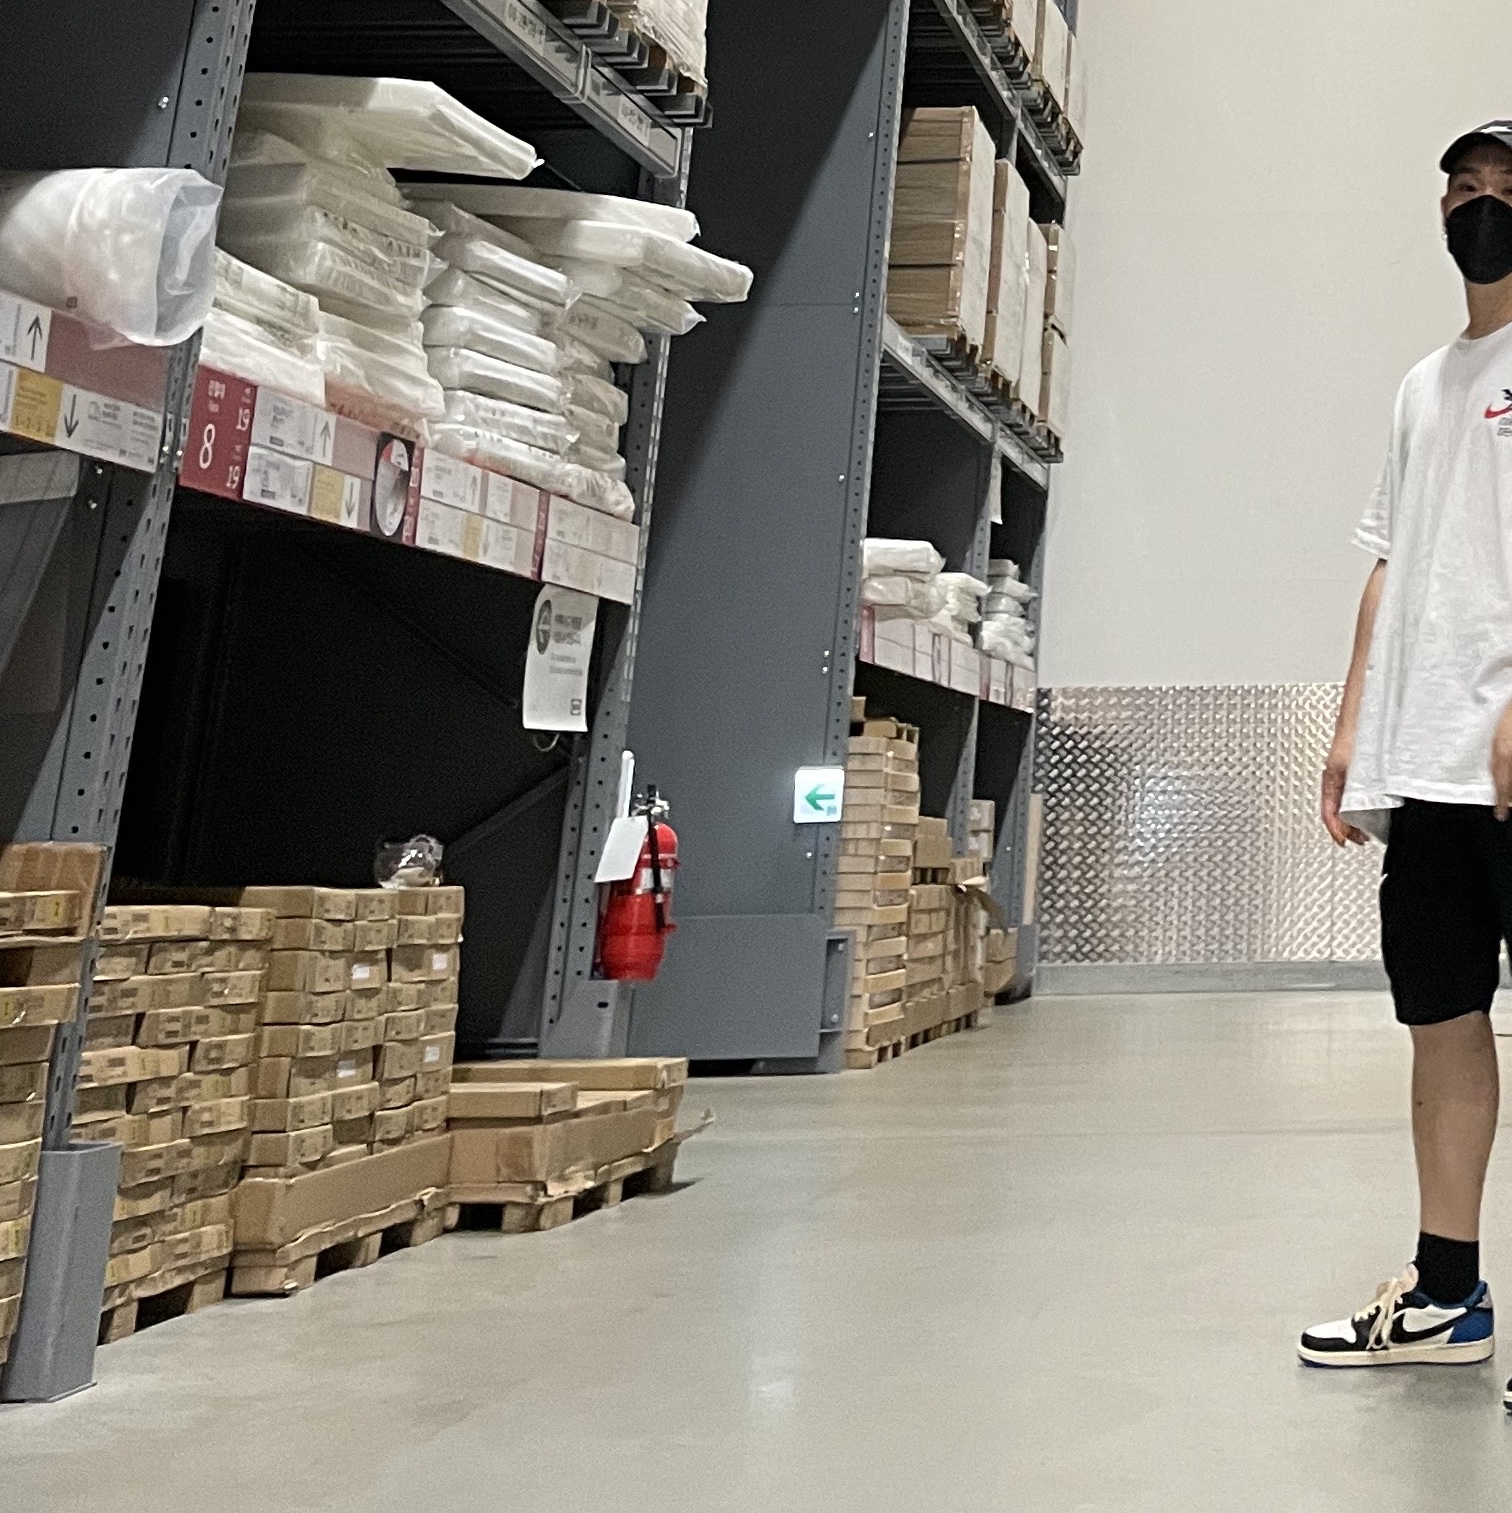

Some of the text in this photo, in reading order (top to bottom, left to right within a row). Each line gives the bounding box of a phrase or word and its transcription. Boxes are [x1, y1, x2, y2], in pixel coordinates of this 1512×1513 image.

[236, 407, 251, 431] 19
[199, 422, 216, 470] 8
[226, 464, 241, 490] 19
